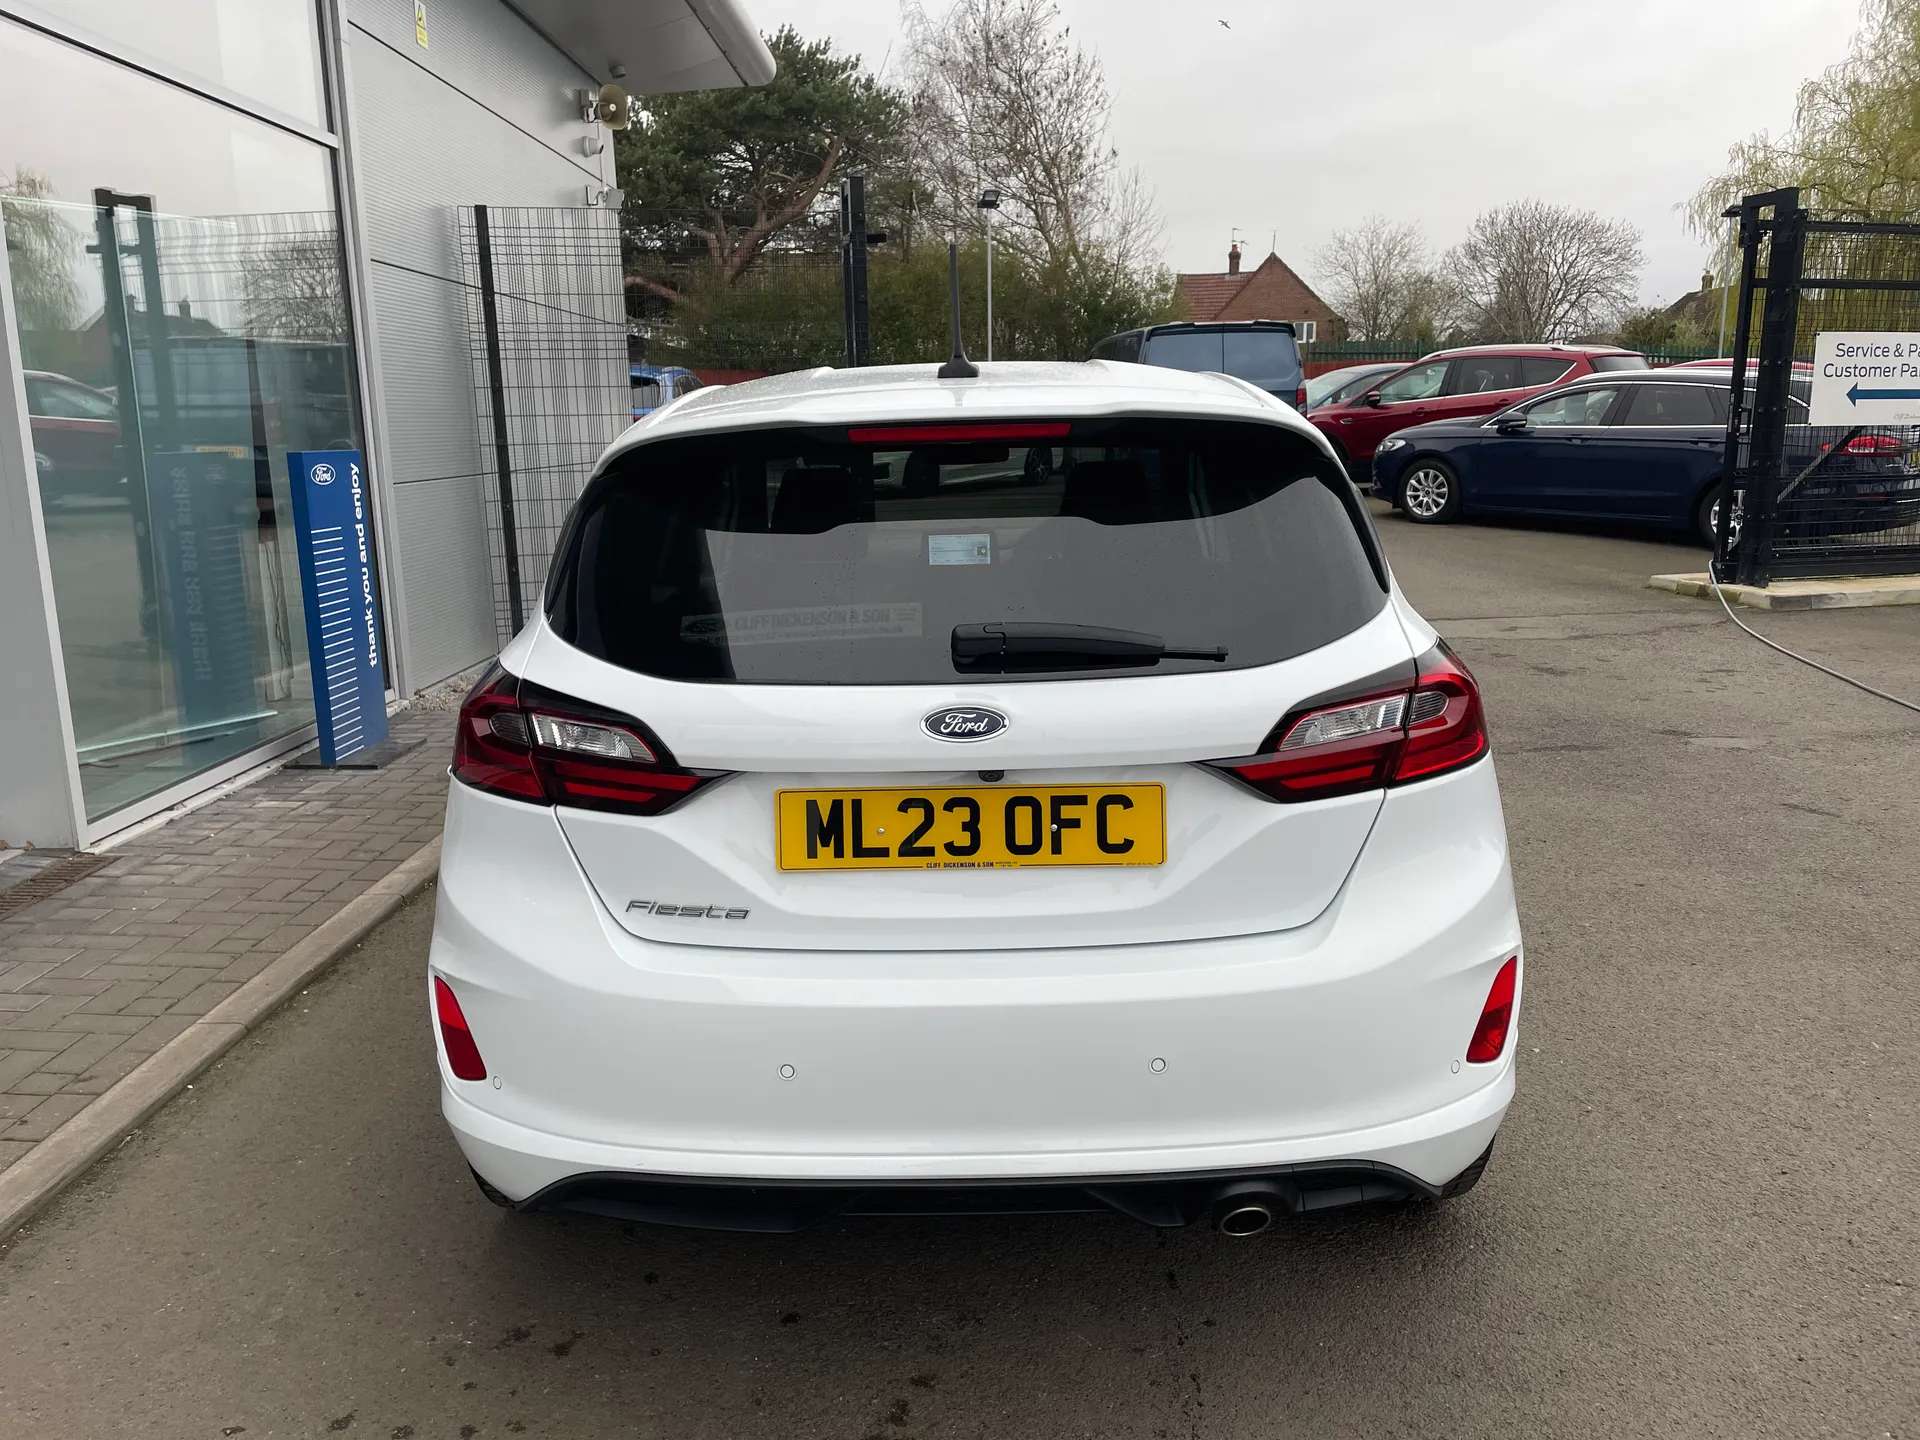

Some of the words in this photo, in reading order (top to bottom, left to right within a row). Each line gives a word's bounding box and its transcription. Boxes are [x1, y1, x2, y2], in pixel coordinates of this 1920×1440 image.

[1835, 342, 1890, 358] Service
[1893, 343, 1904, 357] &
[1823, 363, 1897, 378] Customer
[1900, 363, 1920, 378] Pa
[350, 462, 363, 520] enjoy
[354, 523, 367, 563] and
[361, 567, 373, 605] you
[862, 607, 891, 624] SON
[364, 607, 378, 668] thank
[940, 713, 989, 733] Ford
[805, 796, 981, 860] ML23
[1004, 793, 1135, 856] OFC
[625, 900, 751, 920] Fiesta
